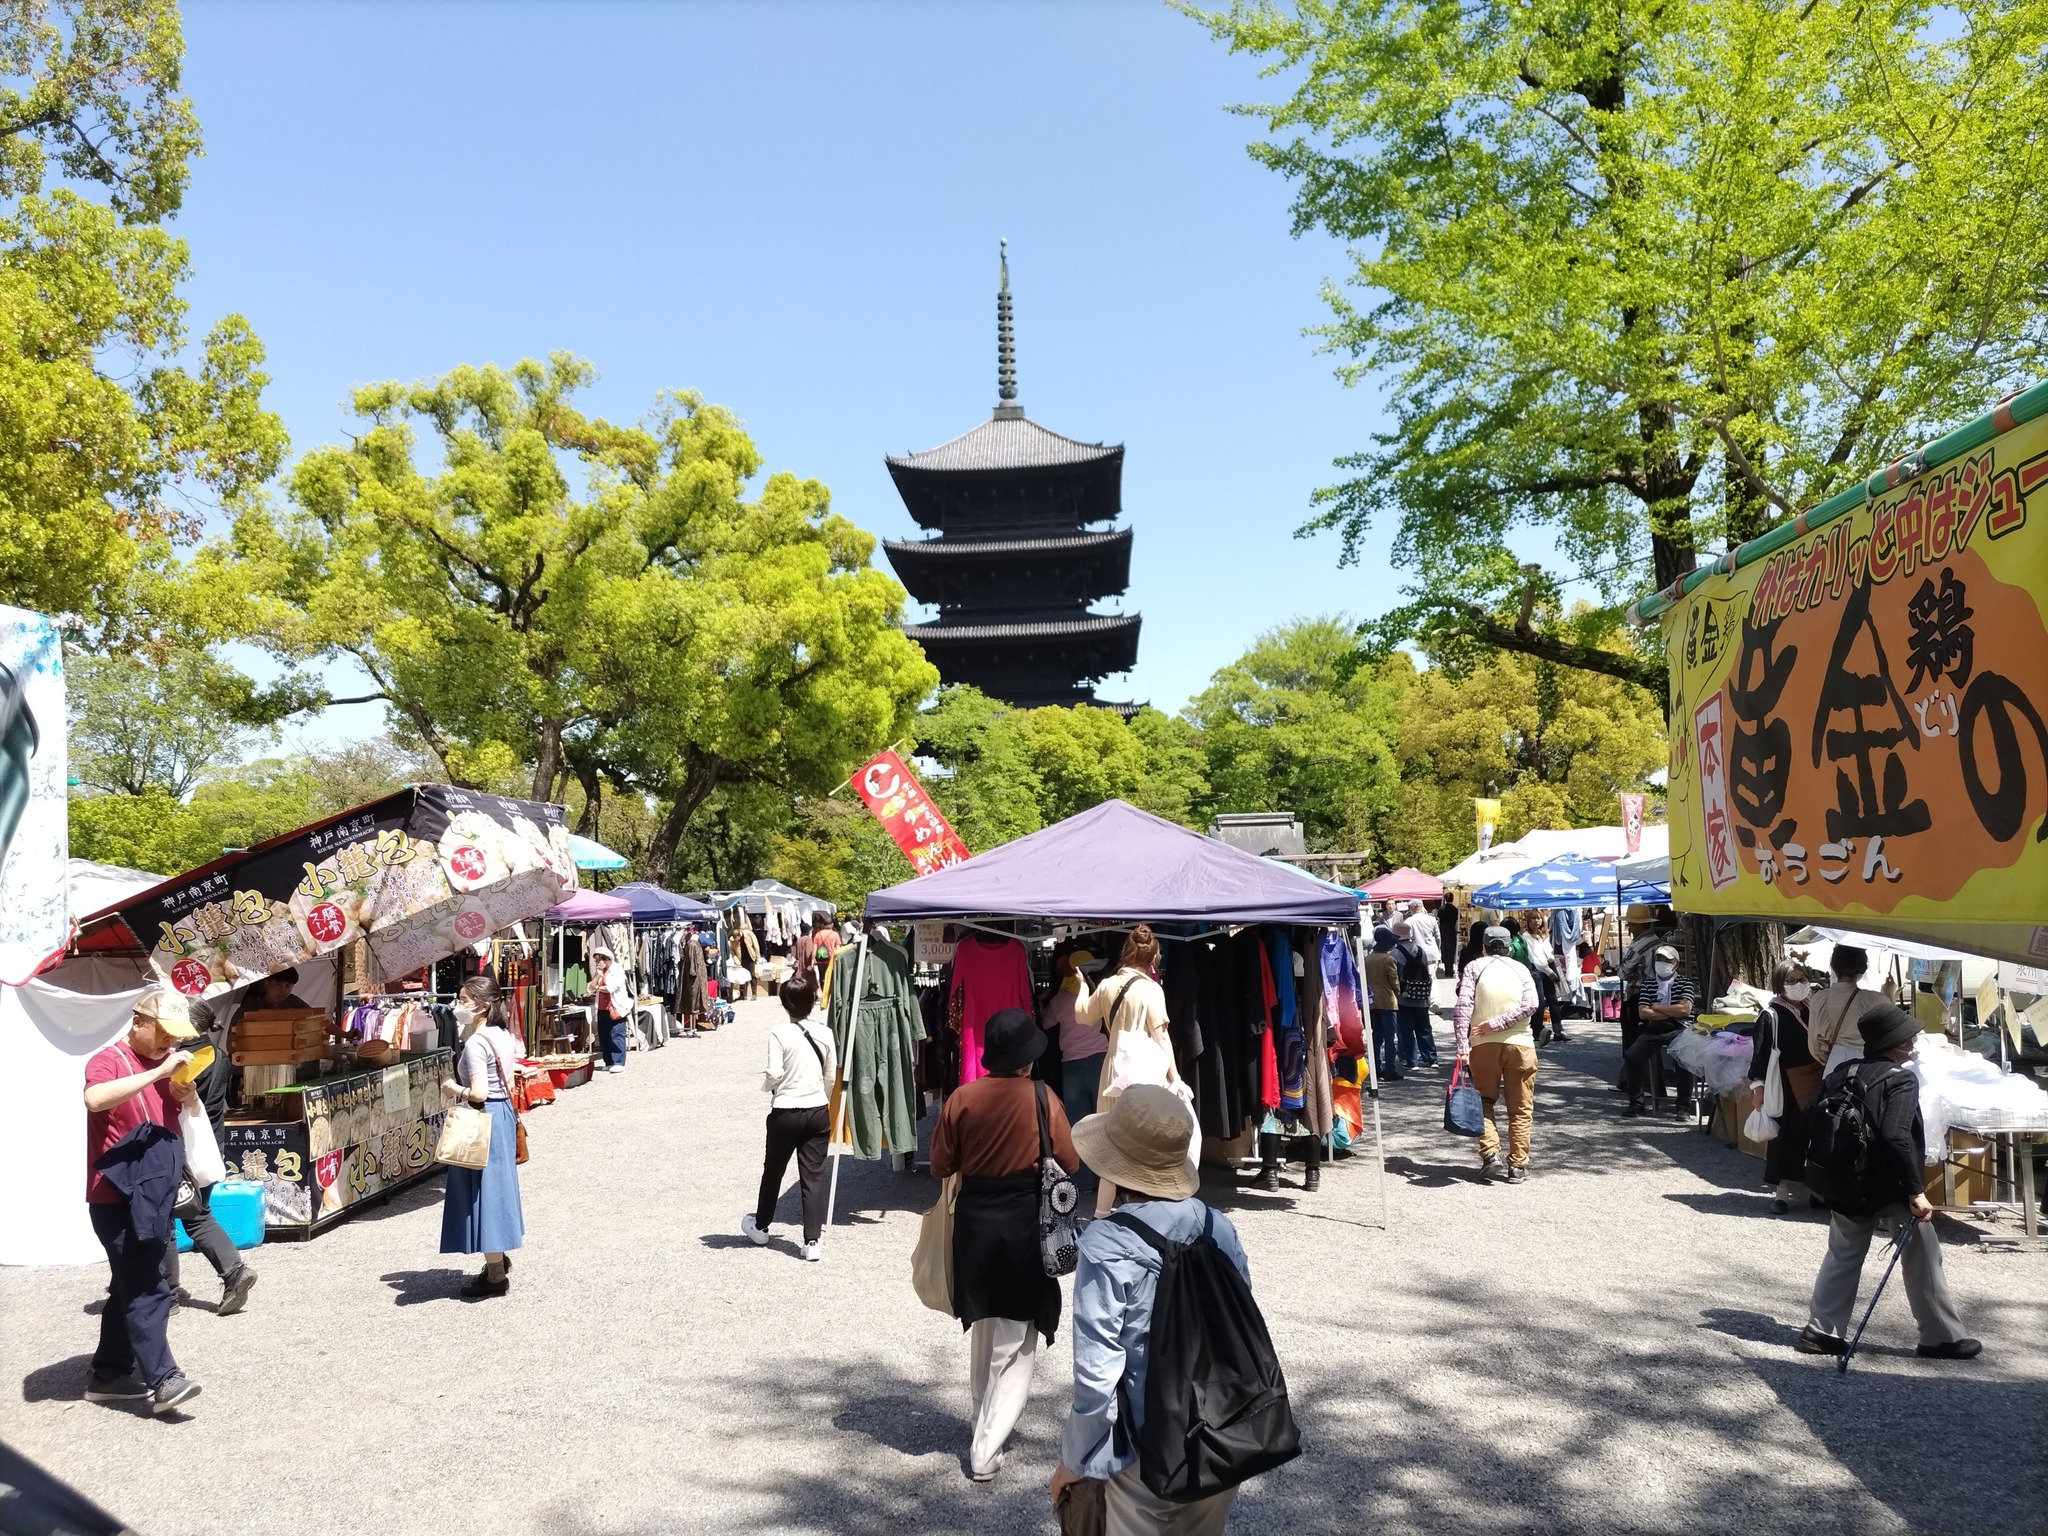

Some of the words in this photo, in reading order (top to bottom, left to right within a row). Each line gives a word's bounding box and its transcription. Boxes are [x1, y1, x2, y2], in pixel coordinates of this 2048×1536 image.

[1913, 689, 1961, 738] どり
[1699, 709, 1731, 877] 本家
[309, 813, 376, 849] 神戸南京町
[298, 828, 417, 898] 小籠包
[316, 845, 335, 855] KOUBE
[1753, 835, 1903, 885] おうごん
[161, 873, 230, 910] 神戸南京町
[158, 889, 273, 955] 小籠包
[309, 912, 330, 941] スープ
[321, 905, 343, 935] 豚骨
[920, 943, 952, 956] 3,000
[173, 966, 195, 995] スープ
[187, 962, 208, 989] 豚骨
[229, 1128, 287, 1141] 戸南京町
[349, 1120, 432, 1193] 小籠包
